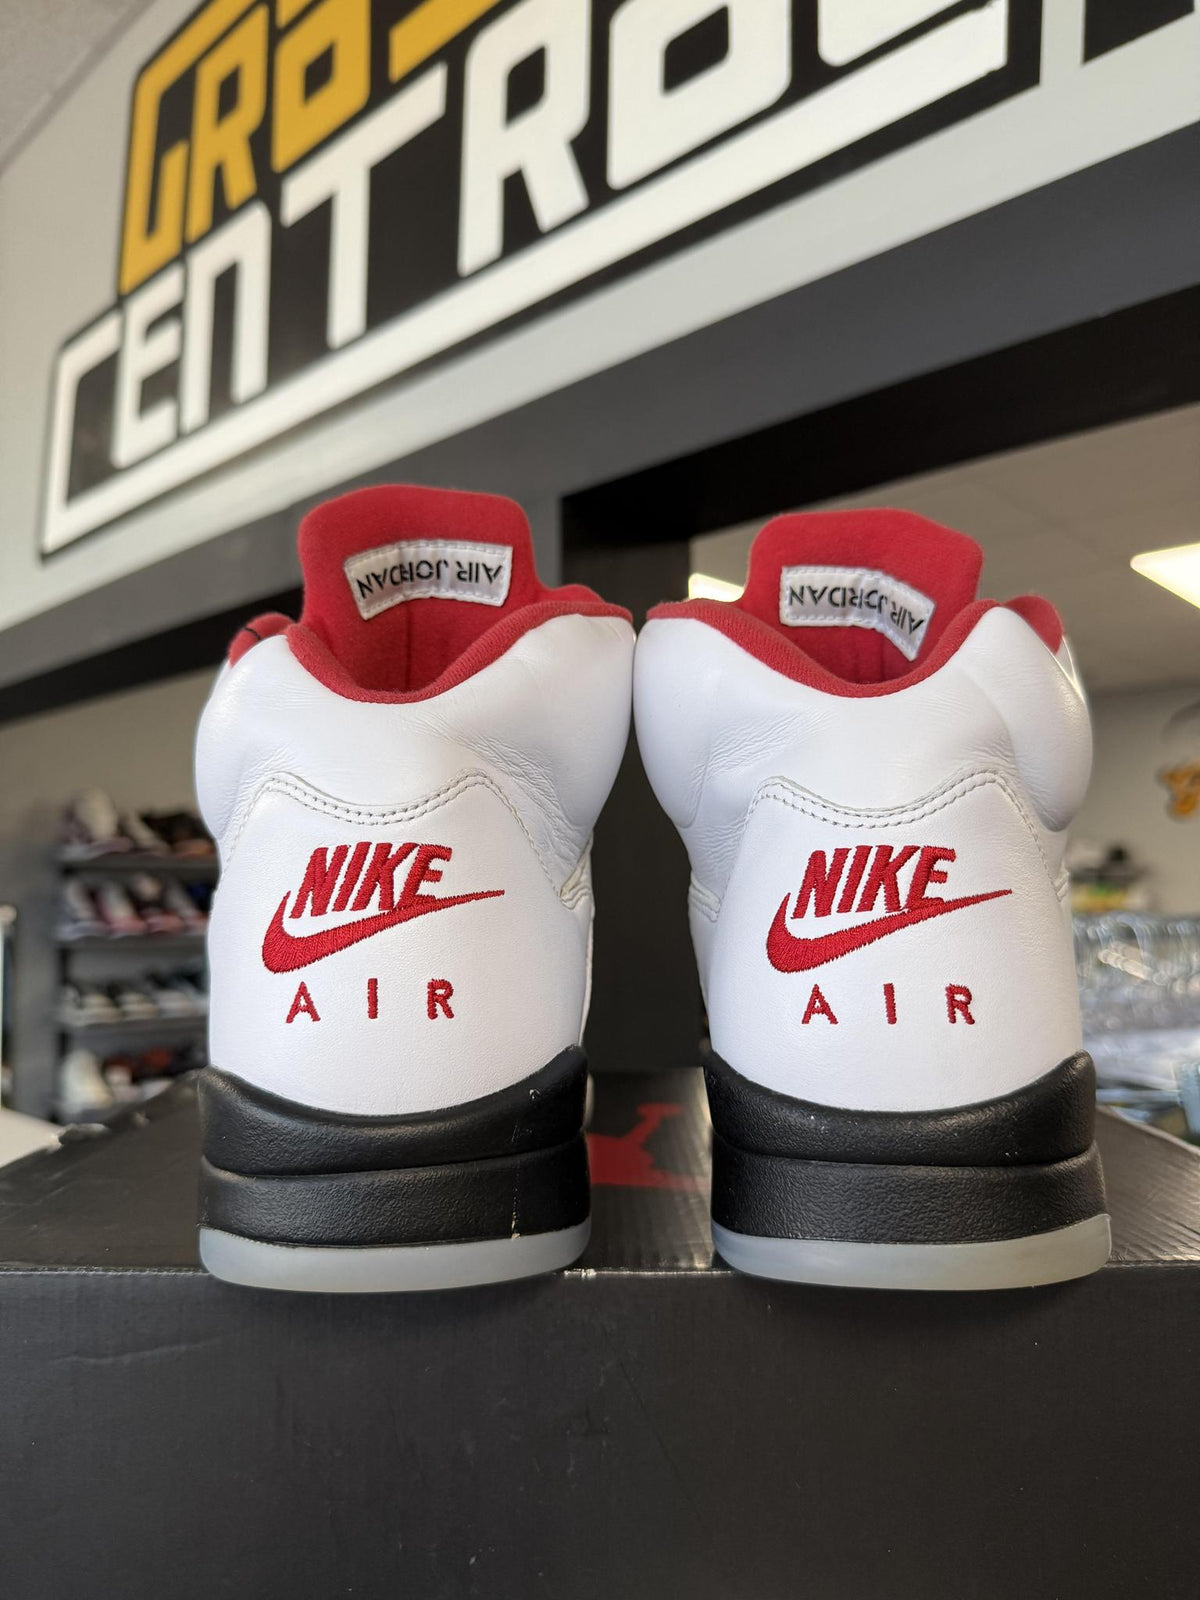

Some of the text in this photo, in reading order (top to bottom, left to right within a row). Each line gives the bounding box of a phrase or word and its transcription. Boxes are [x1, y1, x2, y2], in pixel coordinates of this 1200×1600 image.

[356, 559, 503, 599] AIR JORDAN
[788, 585, 925, 635] AIR JORDAN
[289, 841, 453, 919] NIKE
[790, 844, 957, 919] NIKE
[285, 977, 455, 1024] AIR
[801, 982, 976, 1025] AIR
